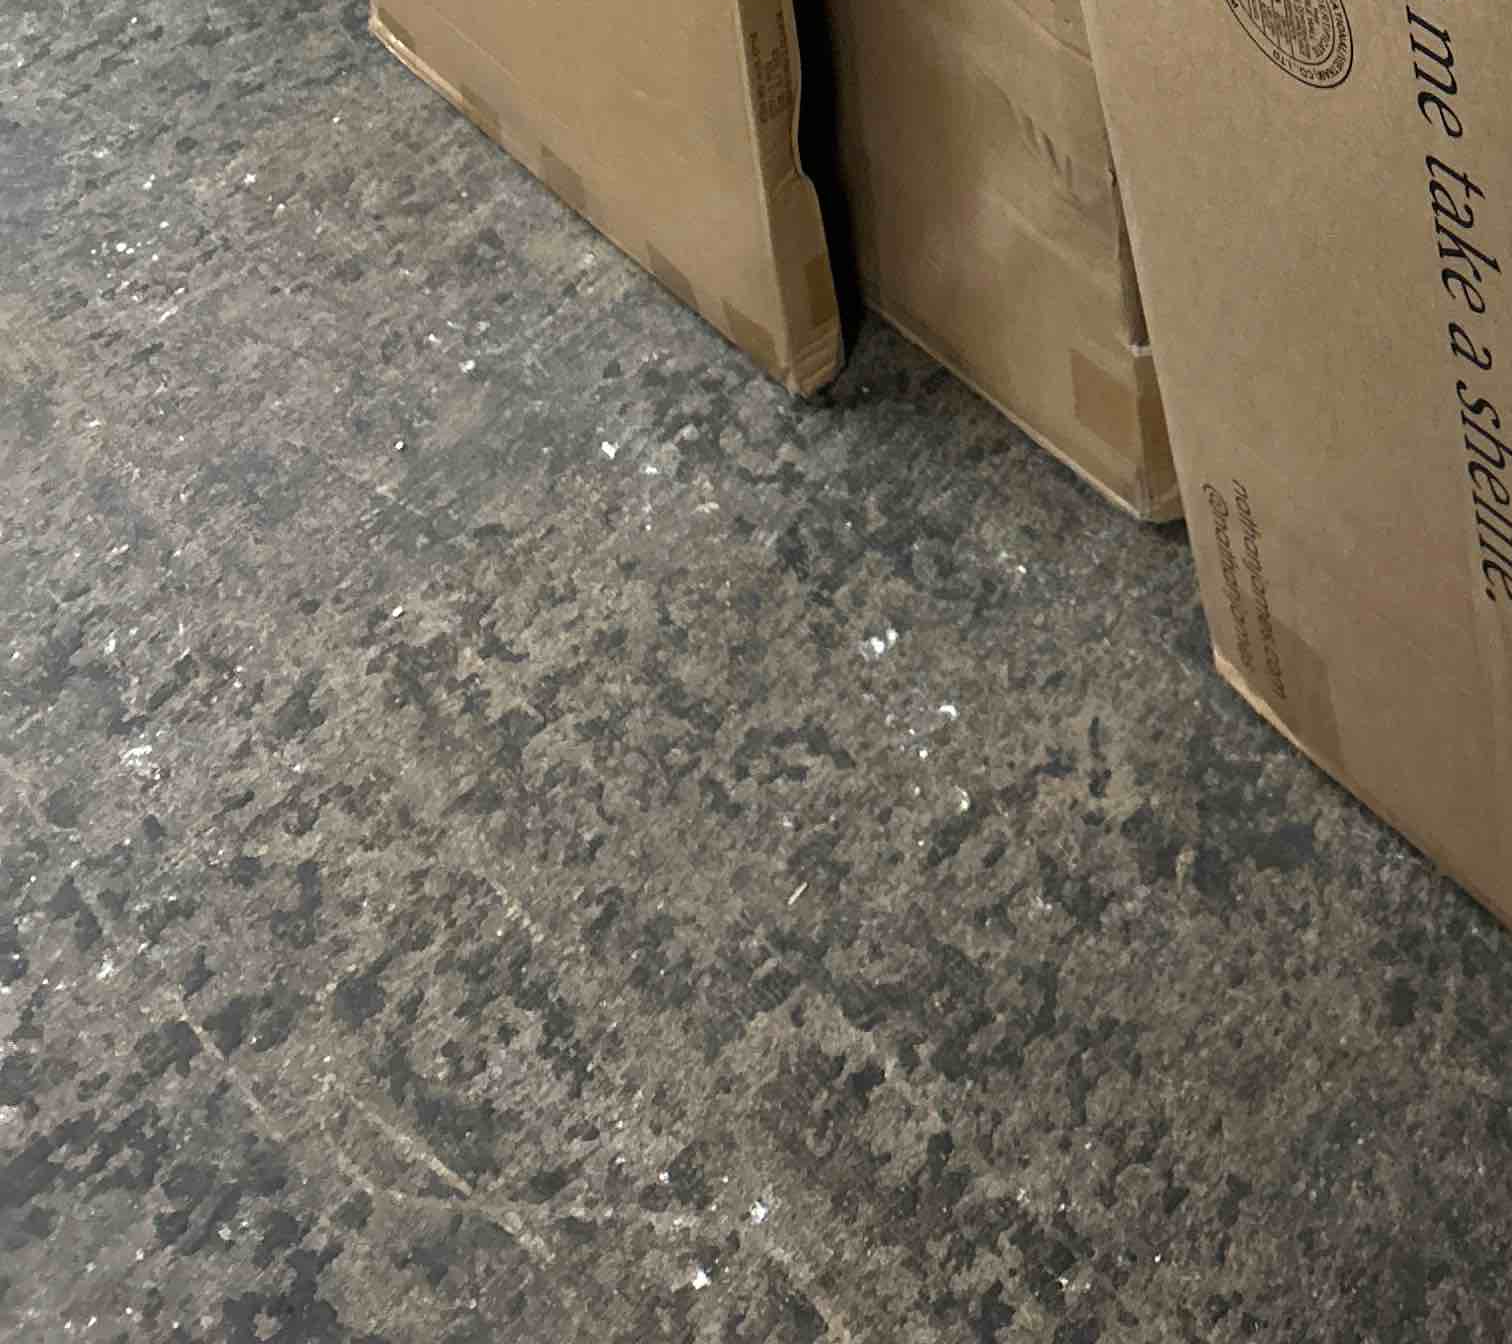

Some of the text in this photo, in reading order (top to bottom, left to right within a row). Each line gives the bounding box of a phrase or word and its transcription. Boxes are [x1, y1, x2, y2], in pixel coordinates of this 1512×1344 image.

[1404, 4, 1464, 140] me
[1424, 154, 1502, 315] take
[1448, 321, 1493, 372] a
